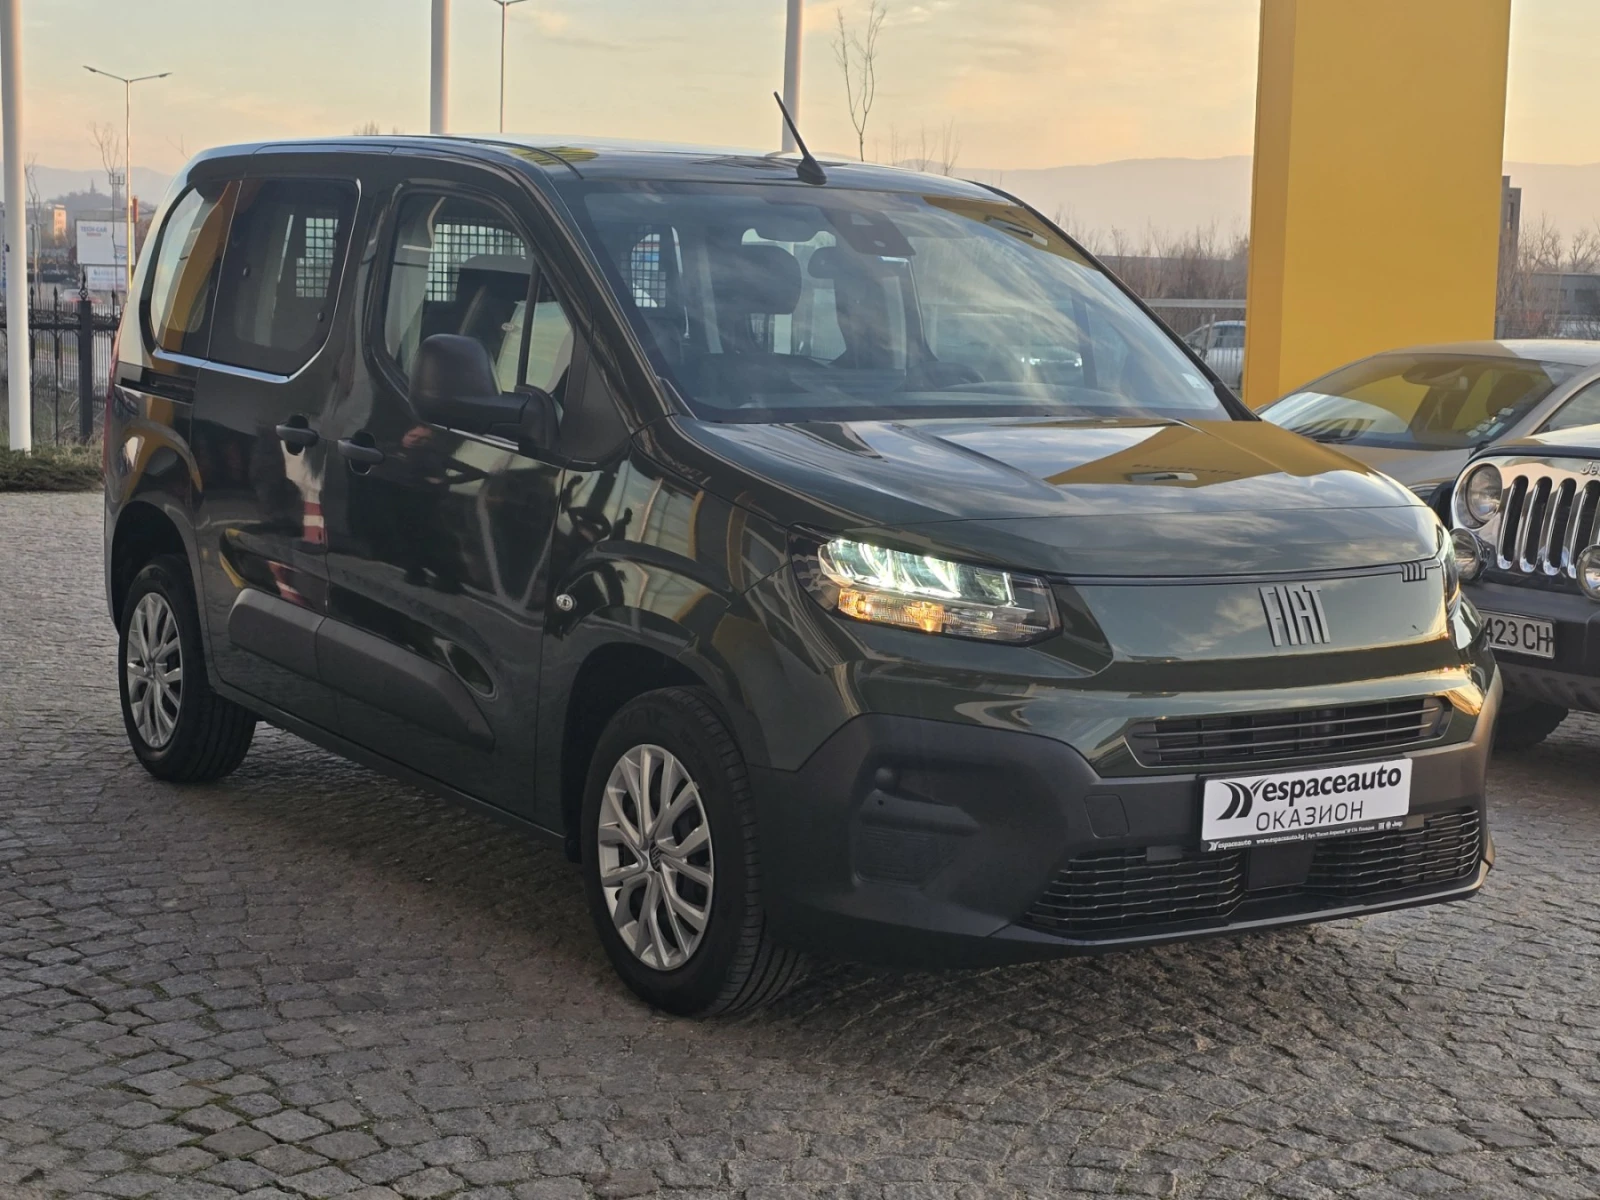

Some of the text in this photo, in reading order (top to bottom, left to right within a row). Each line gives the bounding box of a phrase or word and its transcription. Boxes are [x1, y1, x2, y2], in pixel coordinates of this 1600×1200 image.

[1580, 461, 1600, 475] Je
[1258, 584, 1331, 647] FIAT
[1523, 623, 1550, 653] CH
[1262, 765, 1402, 807] espaceauto
[1256, 801, 1363, 832] ОКАЗИОН
